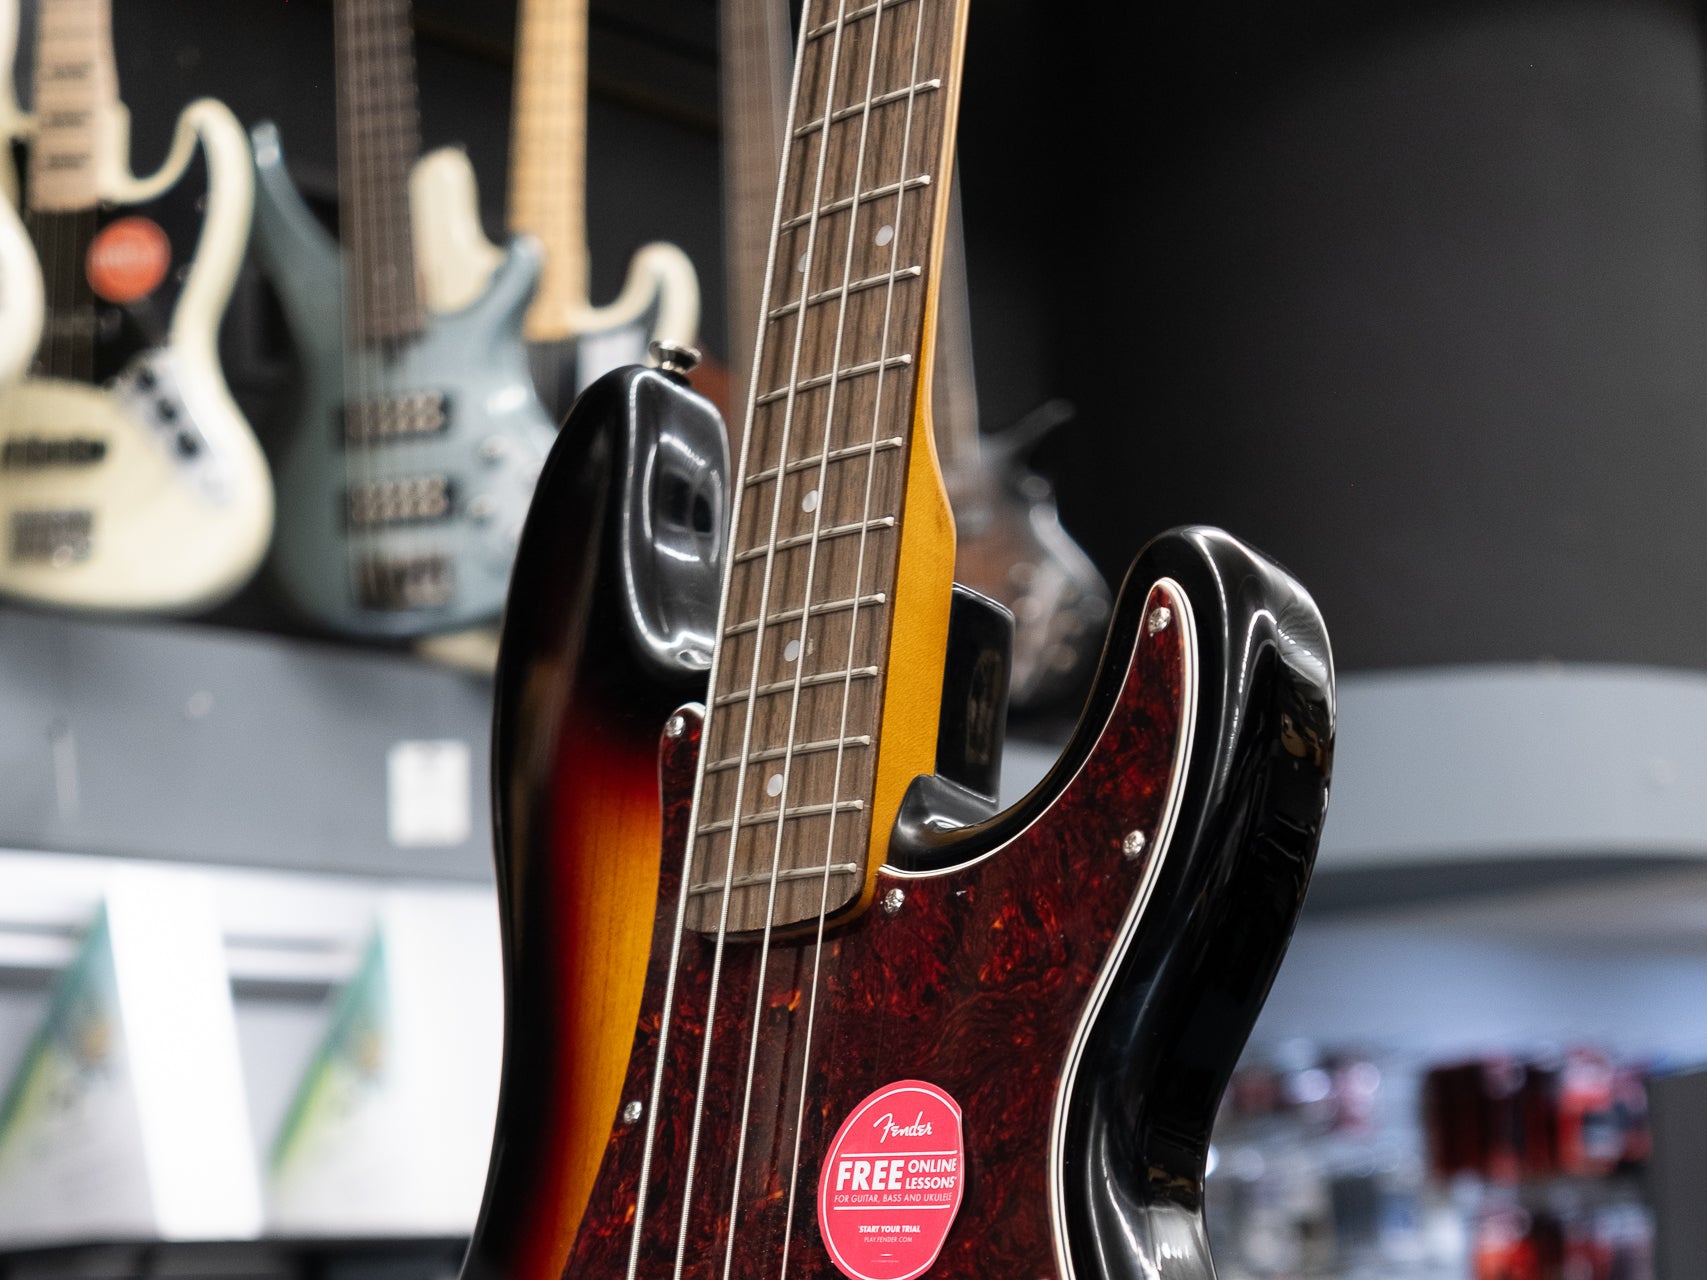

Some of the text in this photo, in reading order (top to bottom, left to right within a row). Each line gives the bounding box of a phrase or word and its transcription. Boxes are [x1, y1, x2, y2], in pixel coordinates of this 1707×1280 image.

[873, 1111, 933, 1143] Fender
[836, 1158, 957, 1191] FREE ONLINE
[905, 1176, 956, 1190] LESSONS
[834, 1192, 952, 1204] FOR GUITAR, BASS AND UKULELE
[858, 1225, 921, 1233] START YOUR TRIAL
